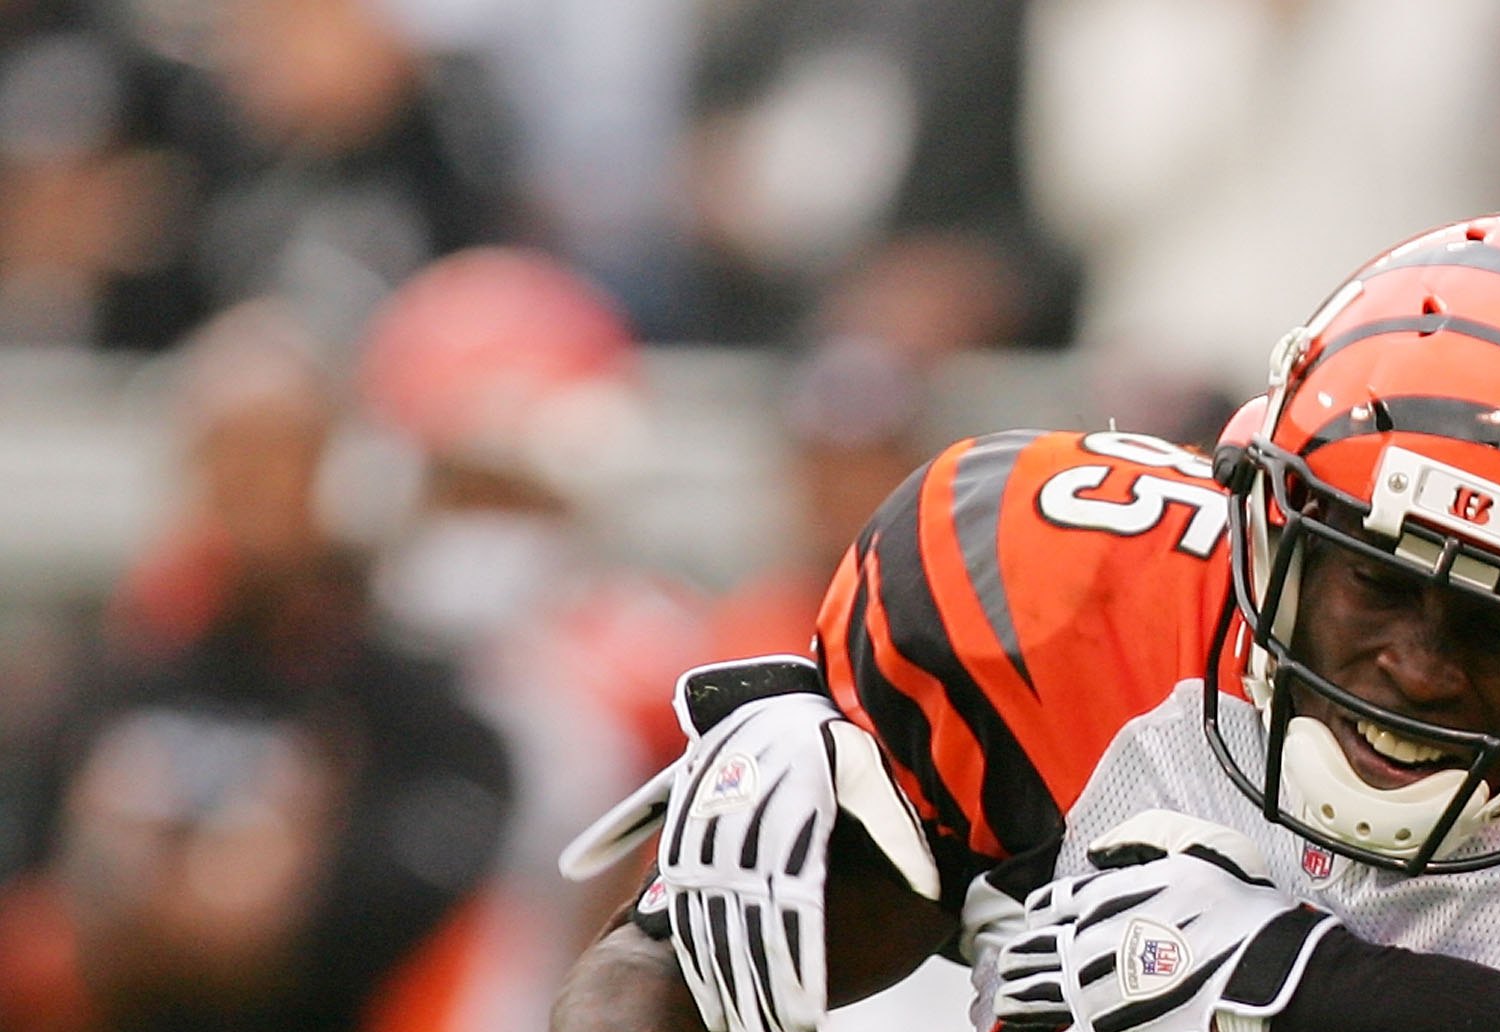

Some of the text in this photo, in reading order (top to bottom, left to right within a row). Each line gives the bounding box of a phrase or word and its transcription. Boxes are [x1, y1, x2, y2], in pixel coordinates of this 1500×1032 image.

[1034, 430, 1232, 560] 85
[1447, 485, 1494, 526] B
[1303, 848, 1331, 877] NFL
[1156, 942, 1178, 974] NFL
